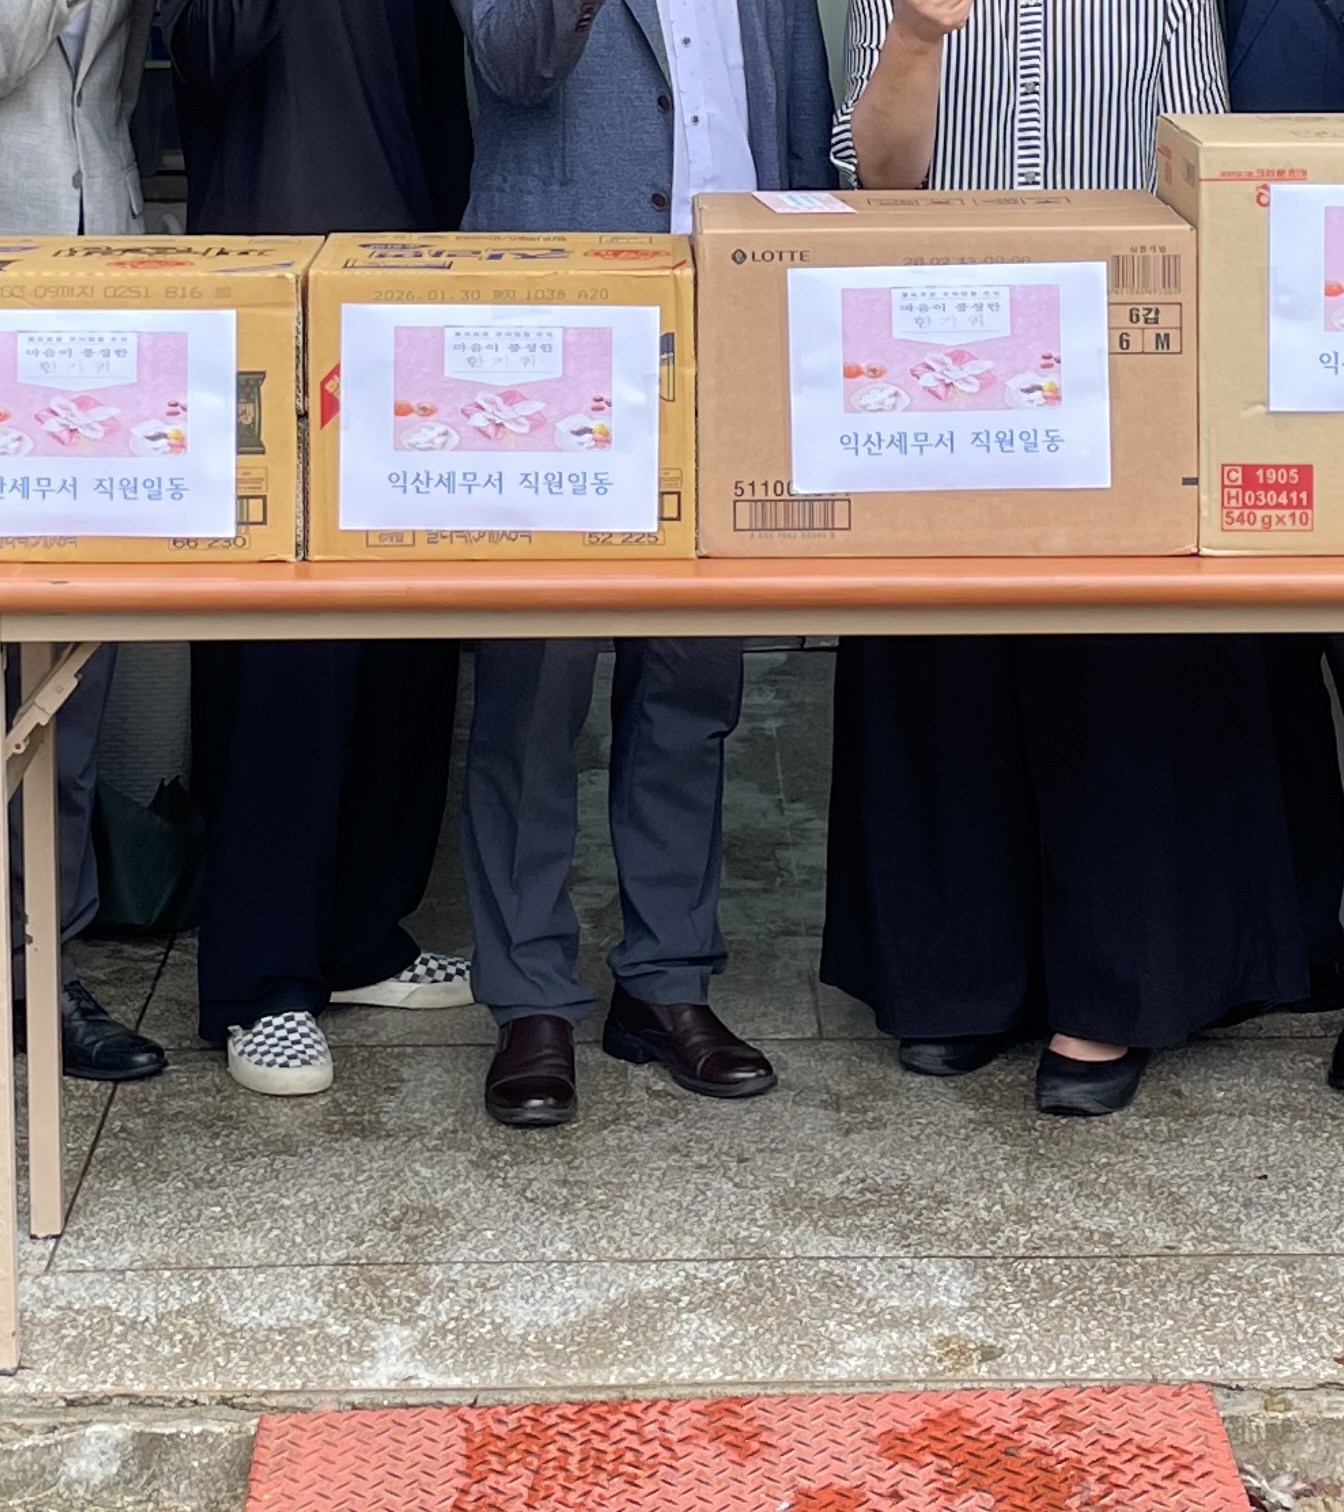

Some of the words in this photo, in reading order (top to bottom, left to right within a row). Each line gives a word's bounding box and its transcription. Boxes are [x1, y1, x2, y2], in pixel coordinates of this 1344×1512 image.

[752, 250, 810, 263] LOTTE
[1129, 307, 1160, 324] 6갑
[1119, 332, 1131, 351] 6
[1155, 333, 1171, 351] M
[839, 431, 956, 457] 익산세무서
[970, 428, 1065, 455] 직원일동
[387, 470, 505, 496] 익산세무서
[518, 470, 614, 496] 직원일동
[1256, 468, 1299, 484] 1905
[93, 475, 190, 501] 직원일동
[1244, 490, 1308, 506] 030411
